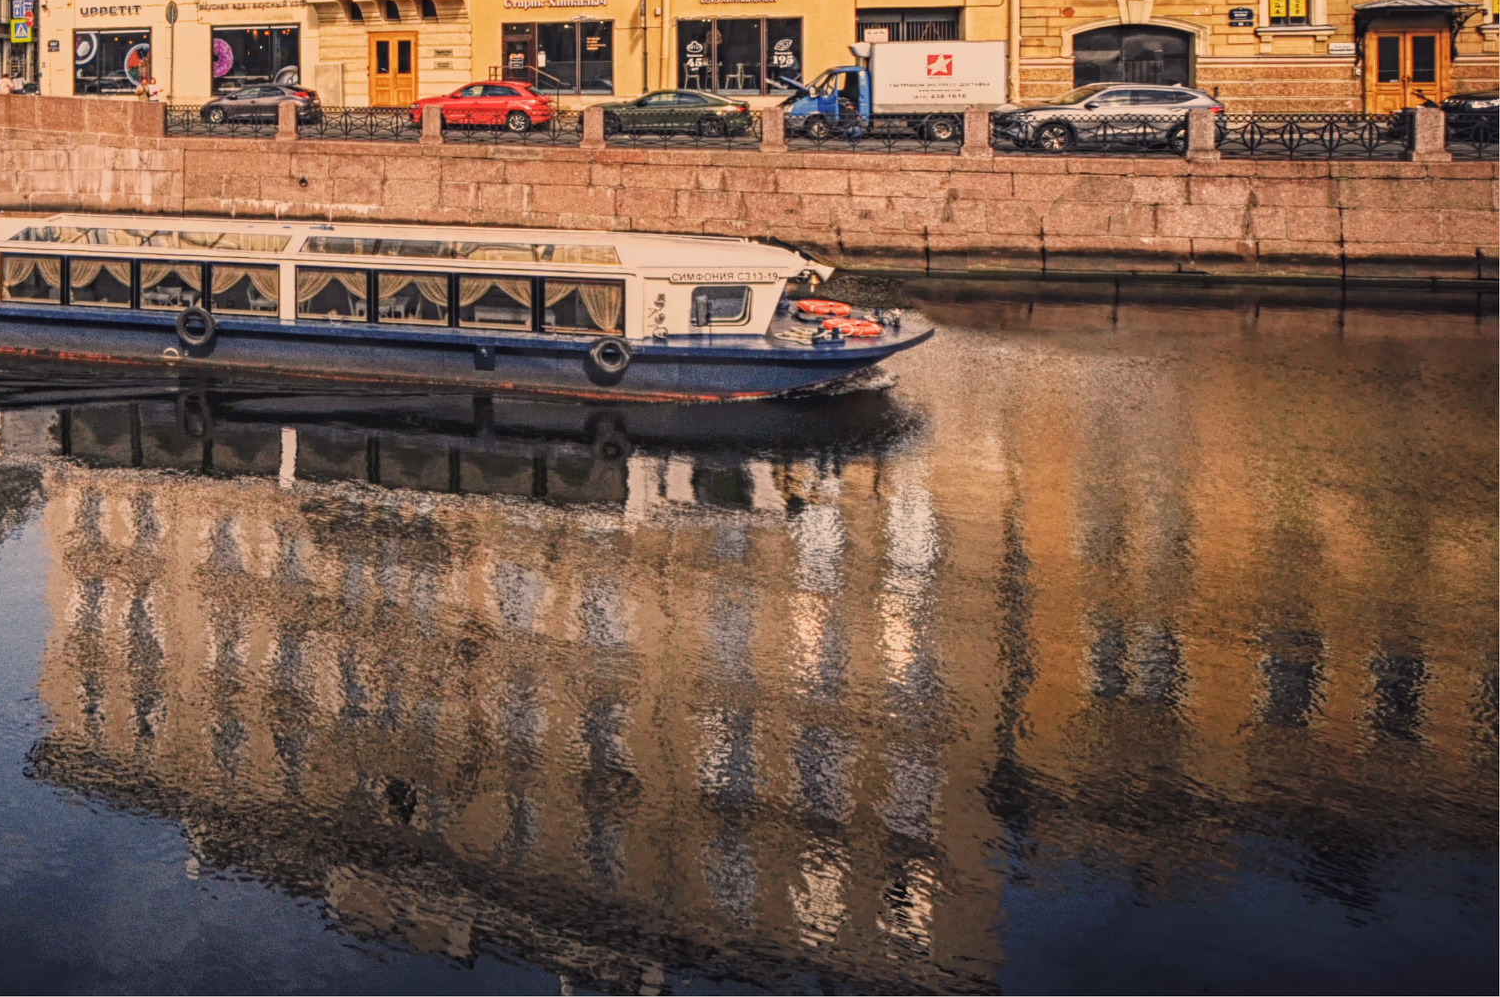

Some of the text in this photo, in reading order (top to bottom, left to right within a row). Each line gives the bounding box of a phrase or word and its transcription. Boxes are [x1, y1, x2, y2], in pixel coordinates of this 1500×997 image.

[504, 0, 545, 10] Старик
[80, 5, 142, 16] UPPETIT
[687, 58, 703, 67] 45
[773, 55, 794, 65] 195
[672, 272, 734, 282] СИМФОНИЯ
